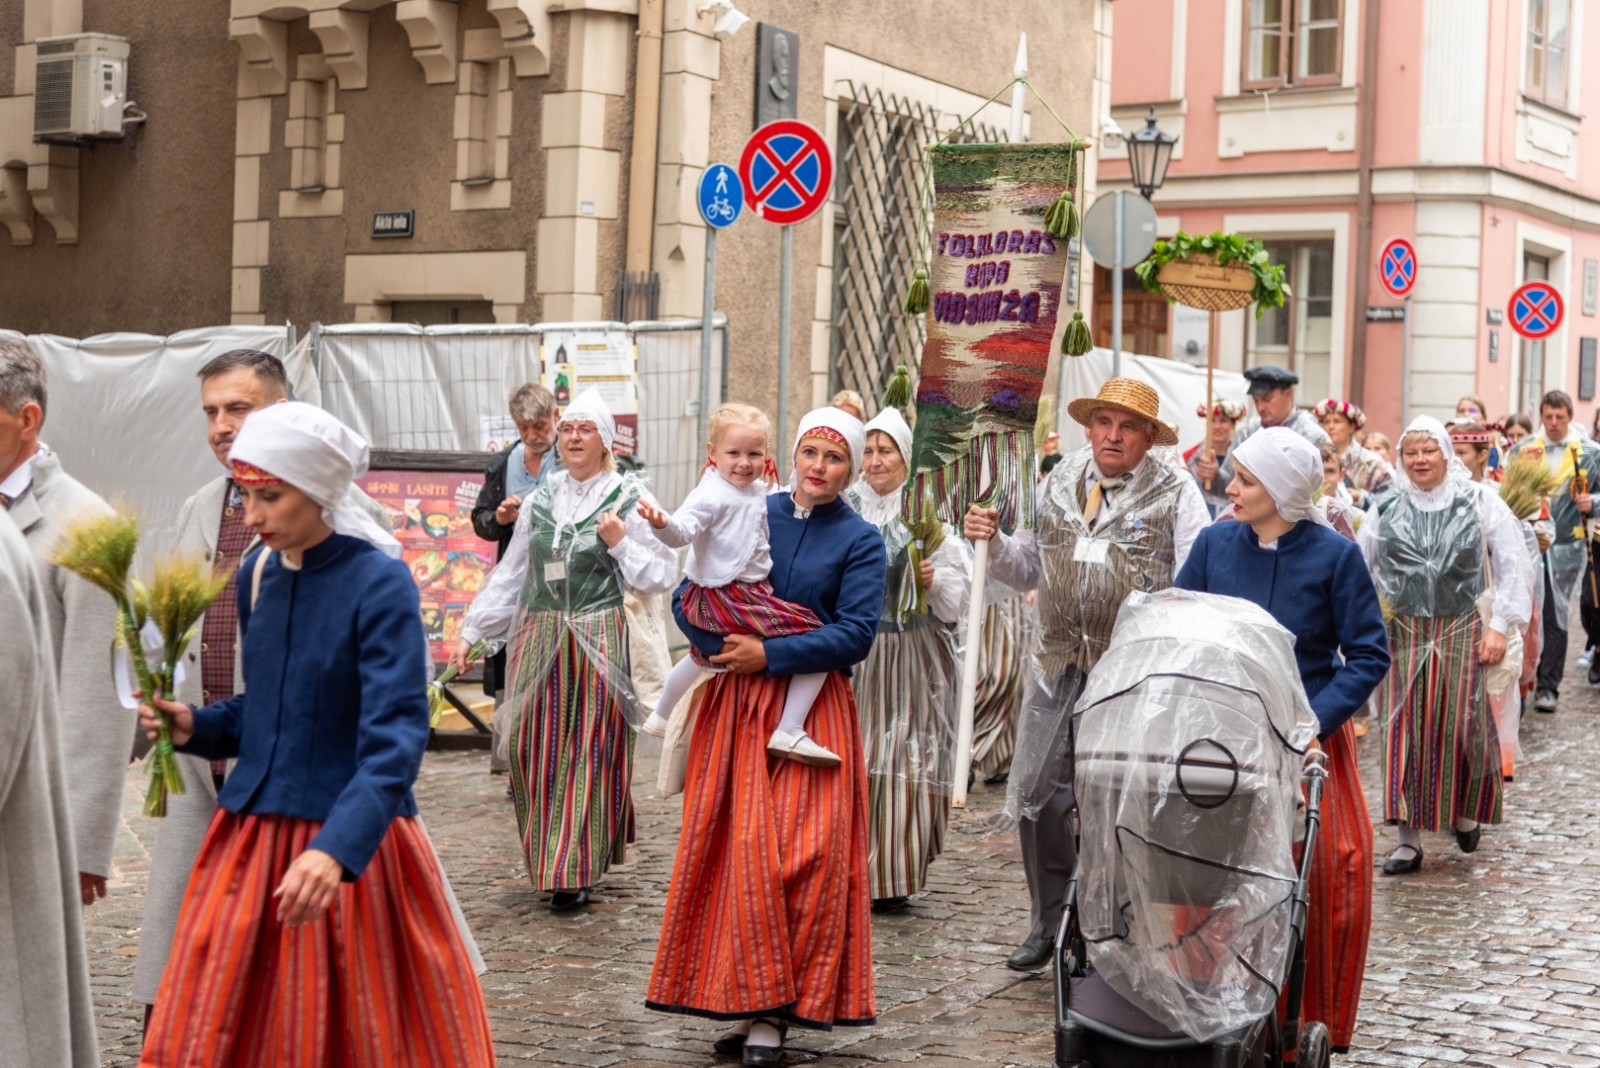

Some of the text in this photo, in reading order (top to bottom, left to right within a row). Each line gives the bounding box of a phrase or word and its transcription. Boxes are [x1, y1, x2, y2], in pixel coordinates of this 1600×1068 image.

[937, 229, 1056, 258] FOLKLORAS
[964, 260, 1011, 289] KOPA
[617, 424, 633, 437] LIVE
[455, 486, 480, 499] MUSI
